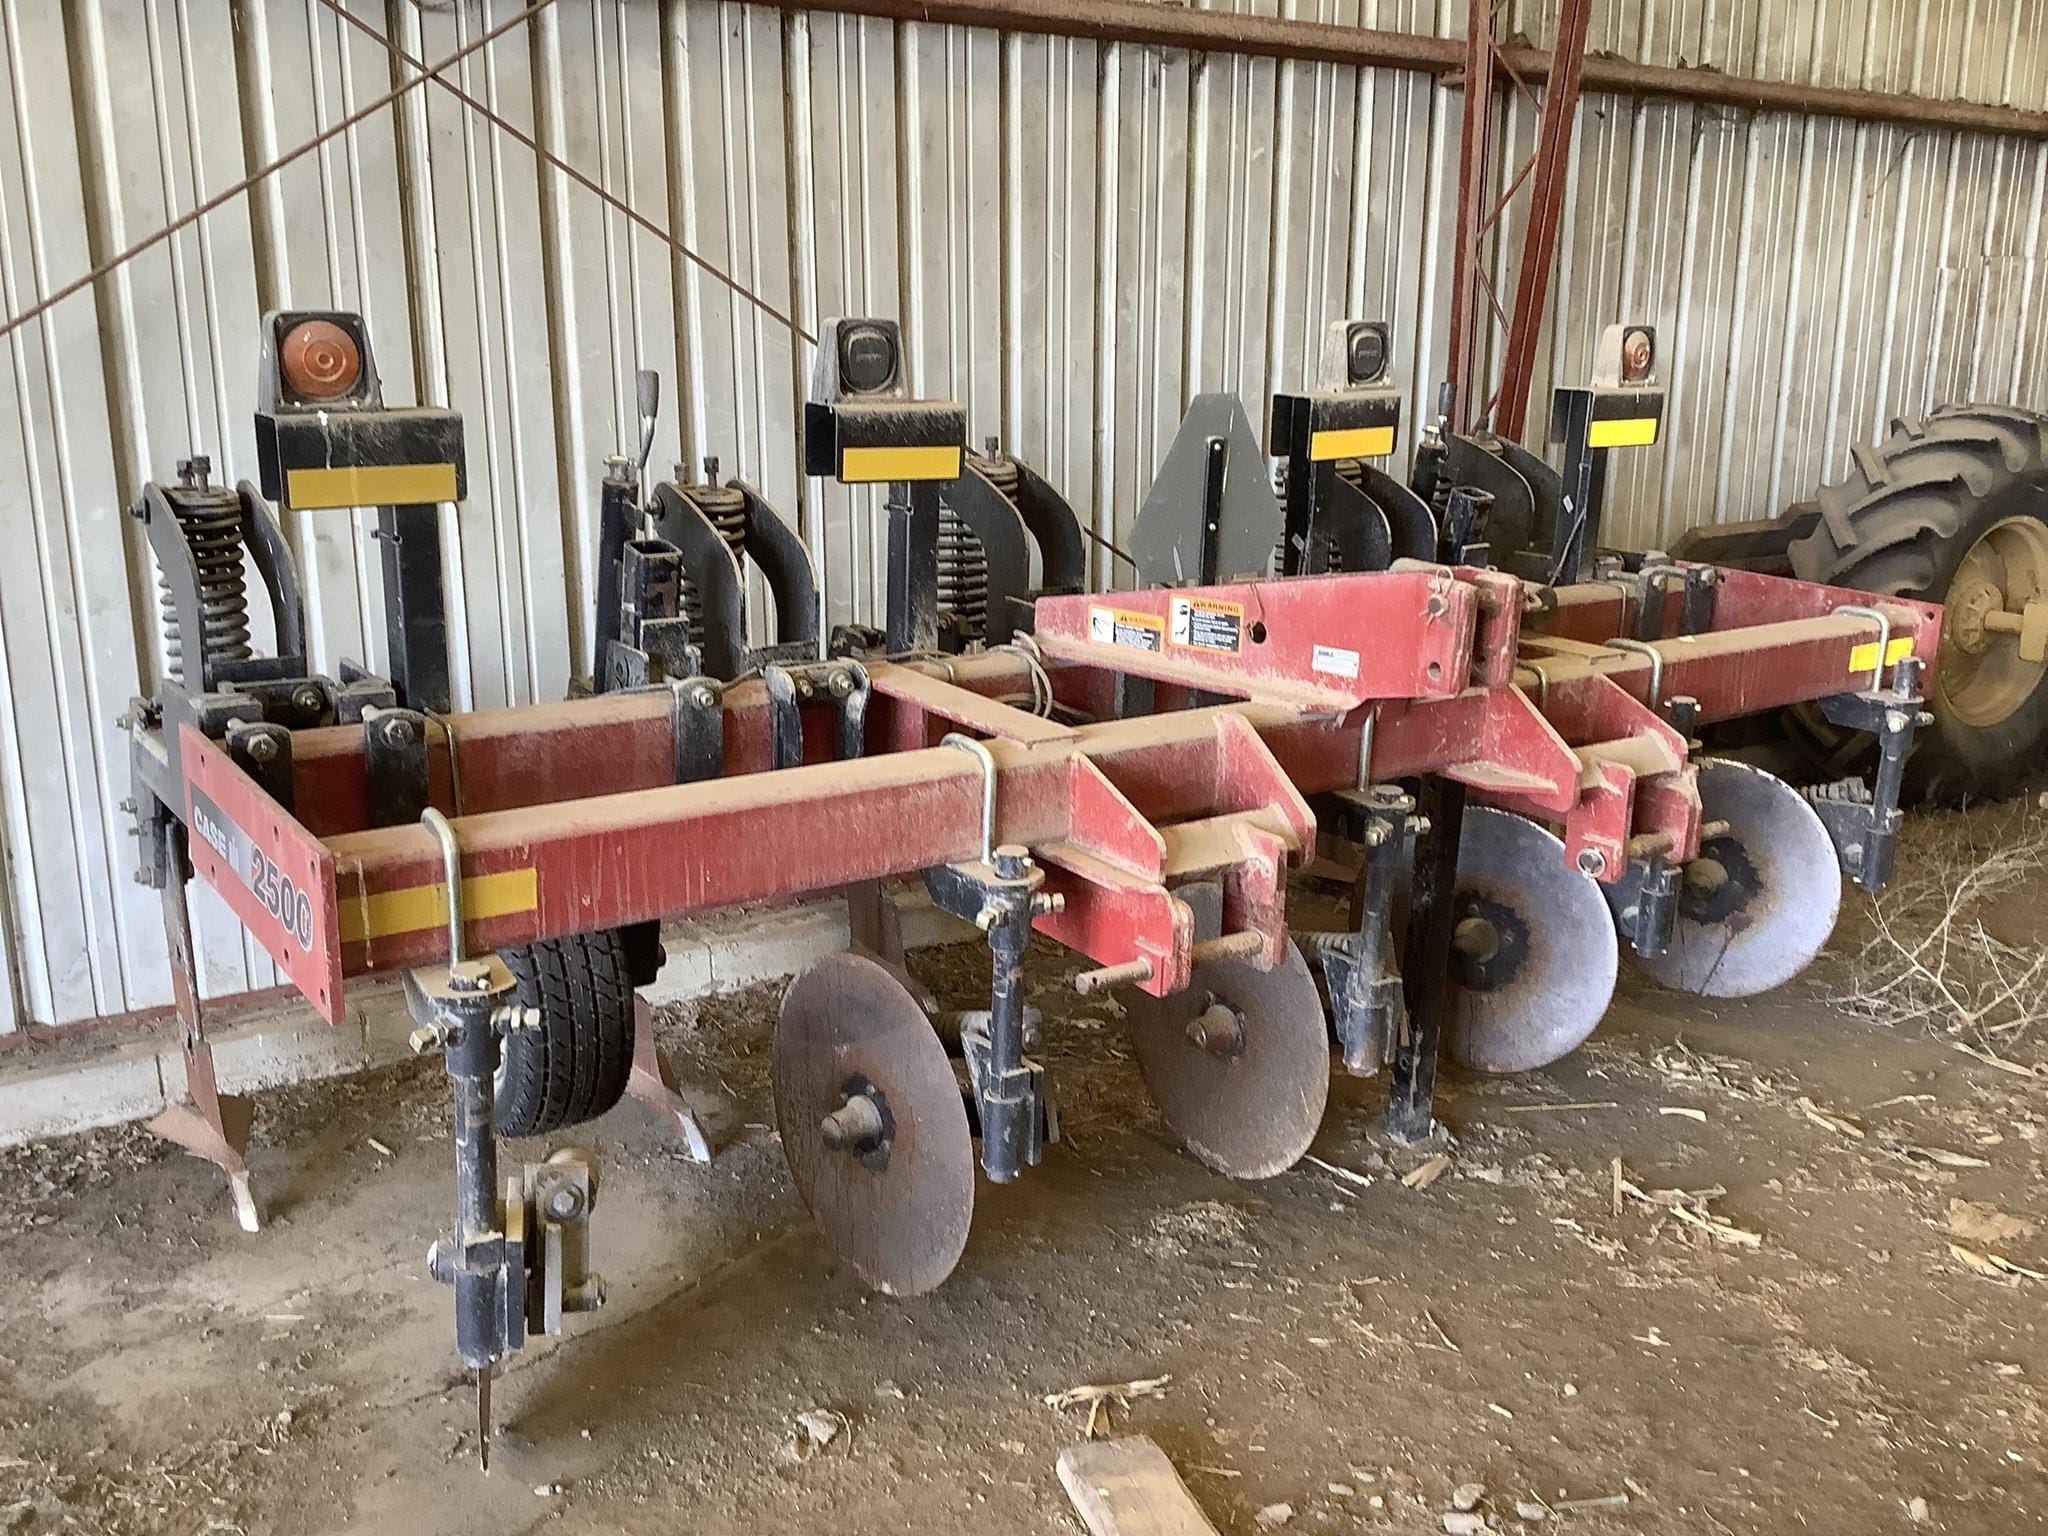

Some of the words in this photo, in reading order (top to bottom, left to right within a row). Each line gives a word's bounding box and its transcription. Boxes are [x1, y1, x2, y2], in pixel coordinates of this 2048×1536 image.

[1200, 601, 1239, 613] WARNING
[194, 805, 227, 860] CASE
[251, 843, 313, 952] 2500
